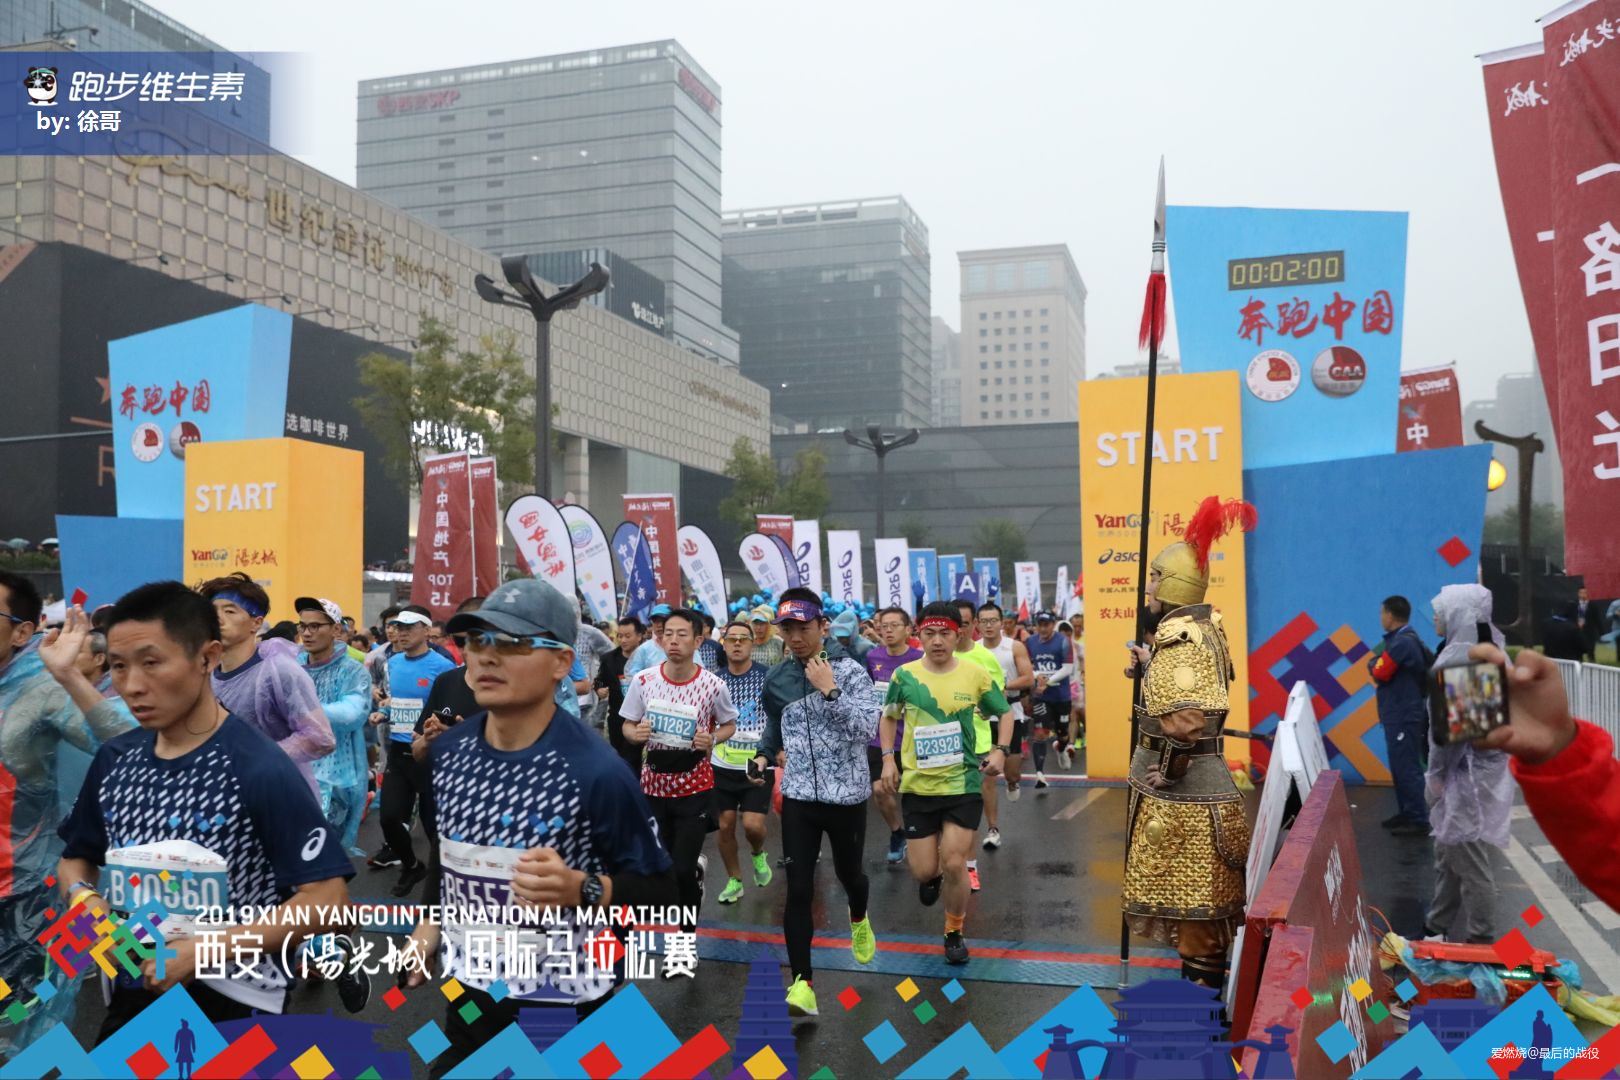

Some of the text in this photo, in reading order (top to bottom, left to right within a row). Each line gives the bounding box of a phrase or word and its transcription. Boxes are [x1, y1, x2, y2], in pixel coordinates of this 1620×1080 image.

[1232, 256, 1340, 286] 00:02:00
[1237, 289, 1394, 346] 奔跑中国
[119, 379, 210, 421] 奔跑中国
[286, 411, 349, 443] 选咖啡世界
[1096, 426, 1224, 468] START
[194, 482, 278, 513] START
[1113, 551, 1140, 562] asic
[958, 574, 976, 594] A
[1100, 607, 1135, 620] 农夫山
[649, 713, 692, 737] B11282
[916, 735, 961, 756] B23928
[110, 869, 220, 910] B10560
